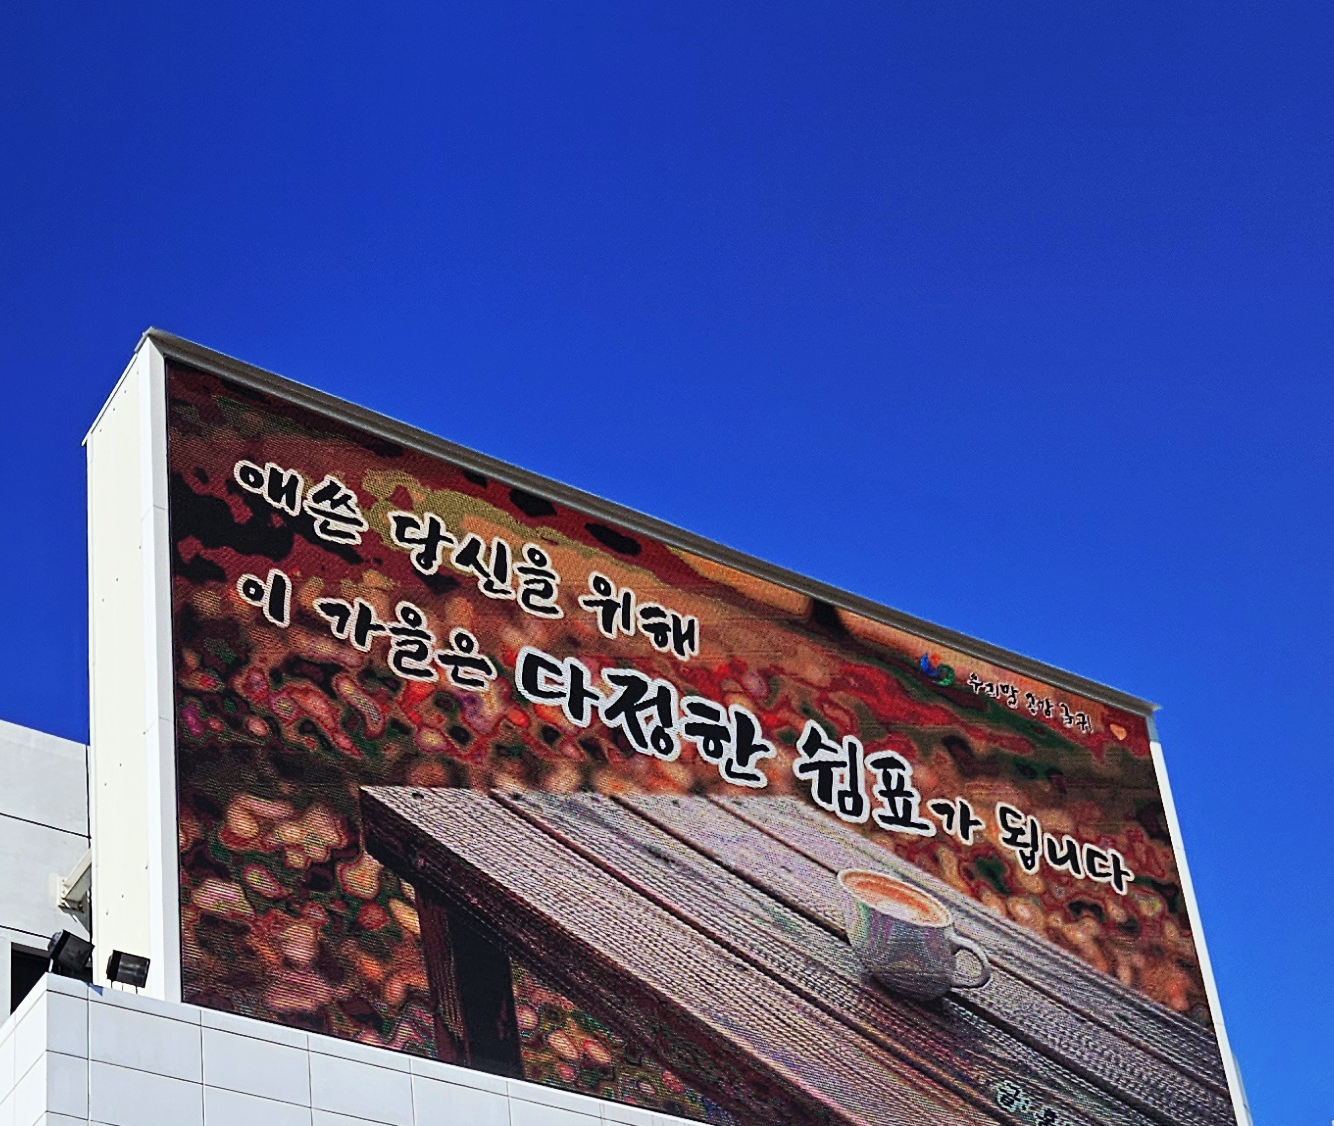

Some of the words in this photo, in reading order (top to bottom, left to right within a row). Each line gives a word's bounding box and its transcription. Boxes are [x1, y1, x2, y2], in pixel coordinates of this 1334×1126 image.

[235, 461, 368, 544] 애쓴
[389, 511, 562, 617] 당신을
[580, 572, 699, 657] 위해
[237, 570, 291, 626] 이
[315, 599, 496, 690] 가을은
[516, 646, 772, 787] 다정한
[795, 719, 984, 846] 쉼표가
[995, 802, 1135, 894] 됩니다
